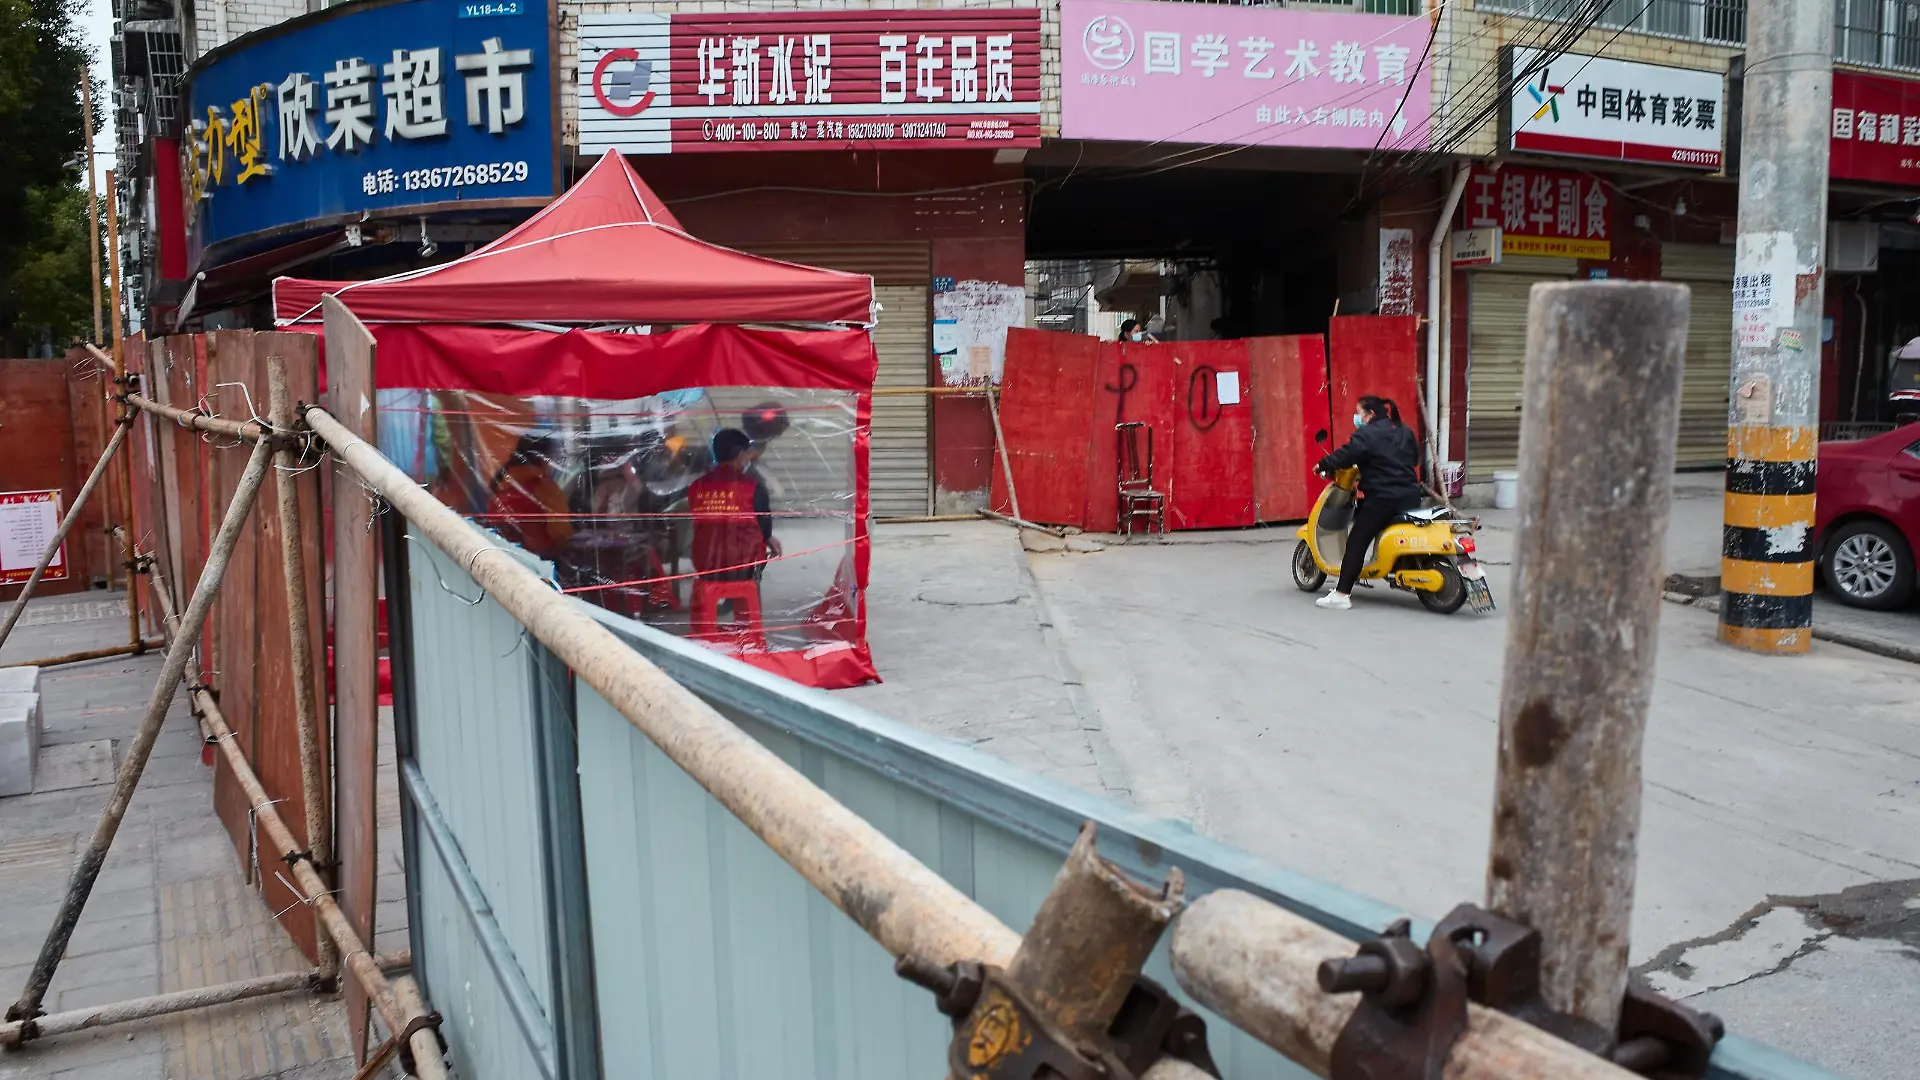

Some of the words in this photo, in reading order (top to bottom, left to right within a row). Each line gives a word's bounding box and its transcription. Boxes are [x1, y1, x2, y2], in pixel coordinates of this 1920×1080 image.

[465, 3, 517, 16] YL18-4-3
[697, 34, 832, 106] 华新水泥
[878, 33, 1013, 103] 百年品质
[1143, 31, 1411, 86] 国学艺术教育
[277, 37, 534, 161] 欣荣超市
[1256, 104, 1384, 128] 由此入右侧院内
[1577, 82, 1718, 131] 中国体育彩票
[715, 122, 780, 141] 4001-100-800
[1471, 172, 1608, 239] 王银华副食
